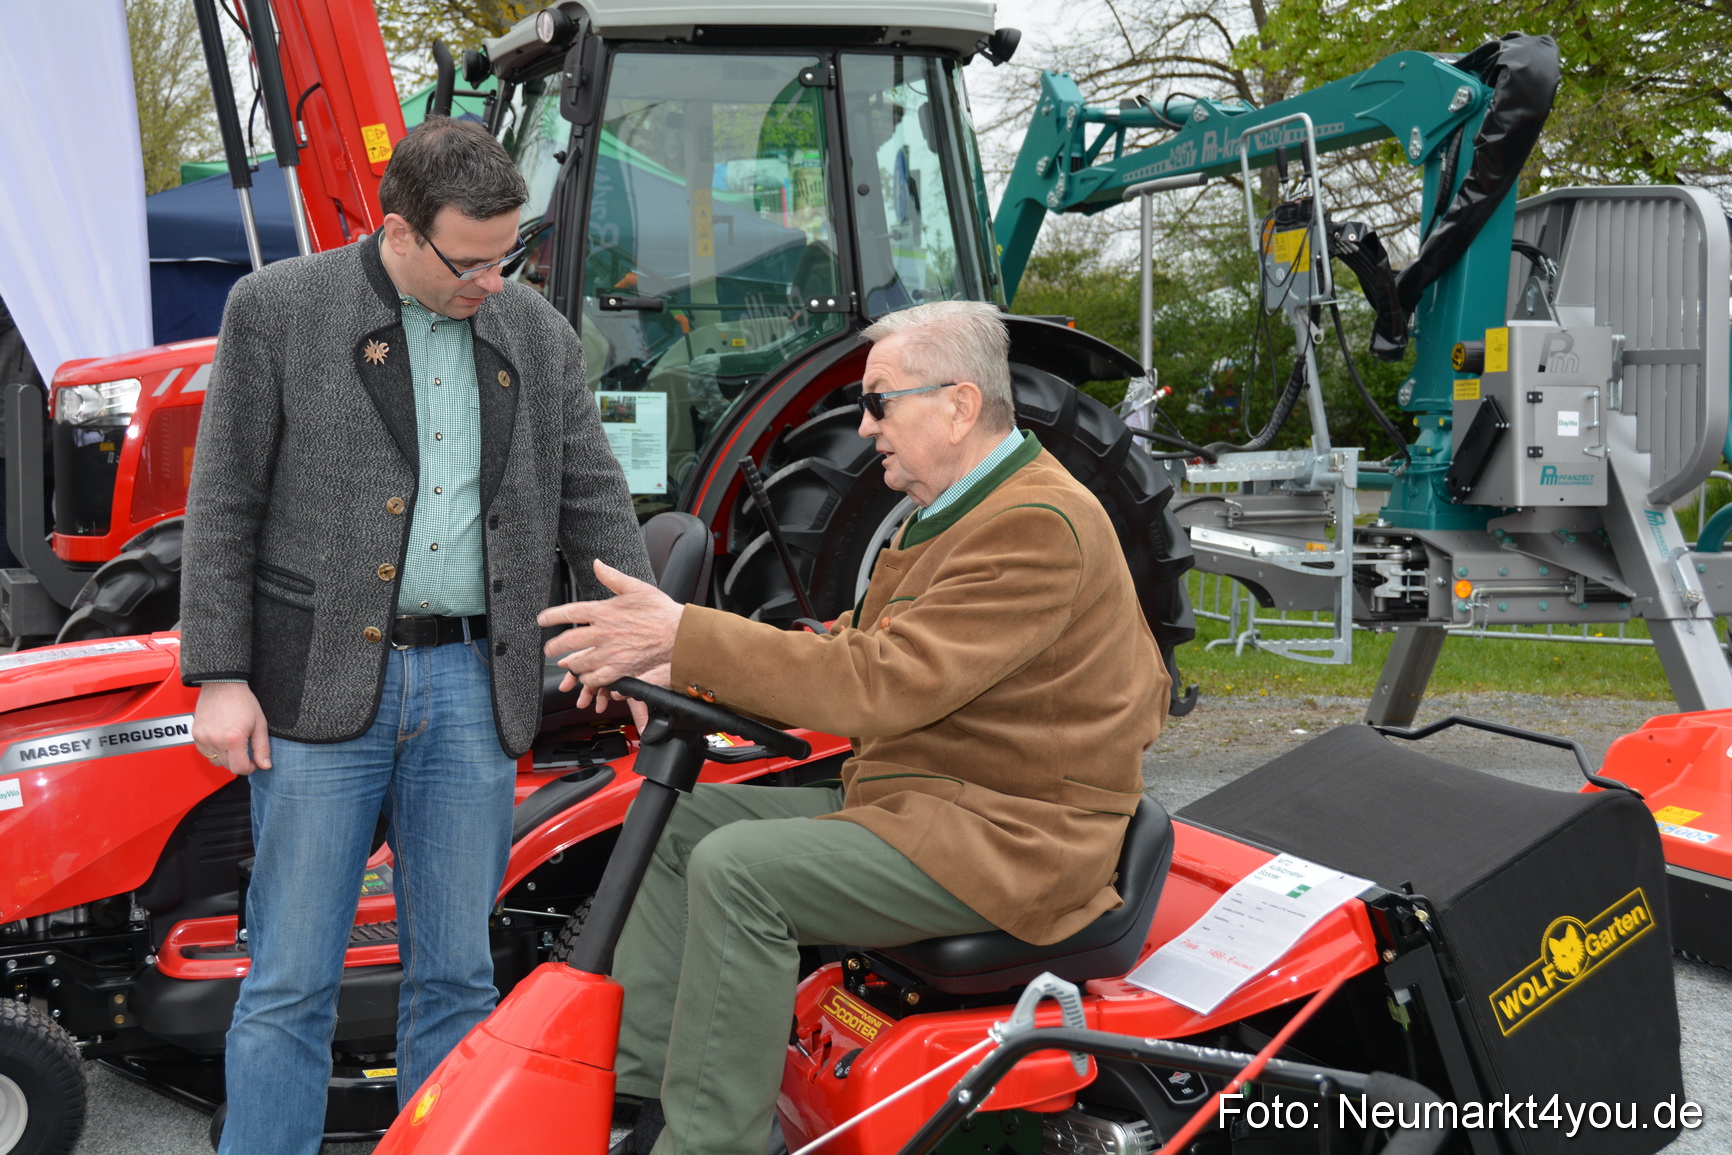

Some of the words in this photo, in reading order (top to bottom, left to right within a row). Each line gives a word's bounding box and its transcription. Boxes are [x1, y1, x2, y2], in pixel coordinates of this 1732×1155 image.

[20, 738, 92, 762] MASSEY
[99, 723, 189, 748] FERGUSON
[0, 790, 20, 799] ayWa
[1498, 963, 1557, 1020] WOLF
[1585, 905, 1647, 957] Garten
[861, 1013, 882, 1028] MINI
